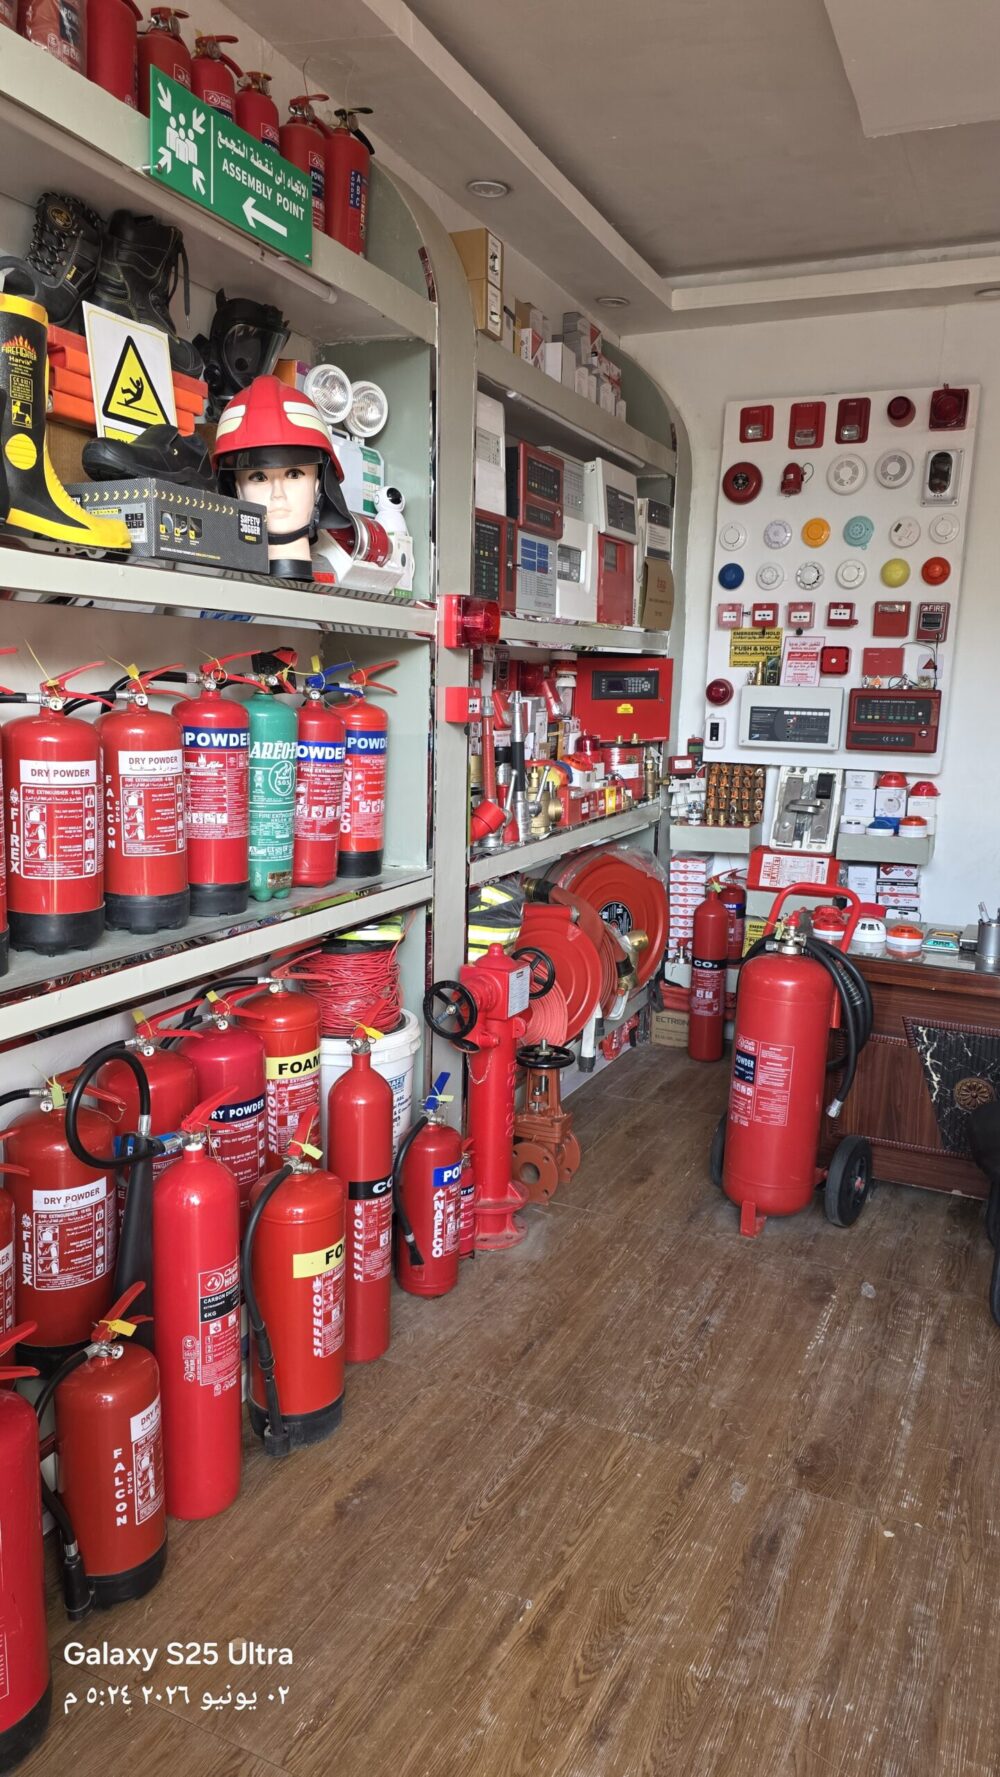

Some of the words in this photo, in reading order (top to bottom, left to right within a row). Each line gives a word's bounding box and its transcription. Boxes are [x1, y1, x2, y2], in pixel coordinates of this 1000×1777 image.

[217, 130, 248, 160] التجمع
[249, 146, 274, 177] نقطة
[222, 158, 273, 201] ASSEMBLY
[276, 192, 305, 221] POINT
[240, 513, 261, 526] SAFETY
[240, 524, 261, 535] JOGGER
[129, 757, 146, 765] DRY
[148, 756, 178, 765] POWDER
[296, 745, 346, 760] OWDE
[31, 768, 50, 777] DRY
[53, 768, 90, 778] POWDER
[105, 774, 116, 849] FALCON
[340, 771, 353, 833] NAFFCO
[10, 808, 20, 874] FIREX
[736, 1053, 755, 1068] POWDER
[211, 1110, 225, 1119] RY
[229, 1098, 265, 1118] POWDER
[267, 1096, 277, 1154] SFFECO
[443, 1165, 461, 1183] PO
[44, 1197, 62, 1205] DRY
[65, 1187, 101, 1204] POWDER
[431, 1199, 444, 1258] NAFFCO
[22, 1231, 33, 1286] FIREX
[325, 1244, 345, 1265] FO
[353, 1218, 363, 1281] SFFECO
[203, 1293, 225, 1304] CARBON
[312, 1295, 323, 1358] SFFECO
[113, 1448, 127, 1527] FALCON
